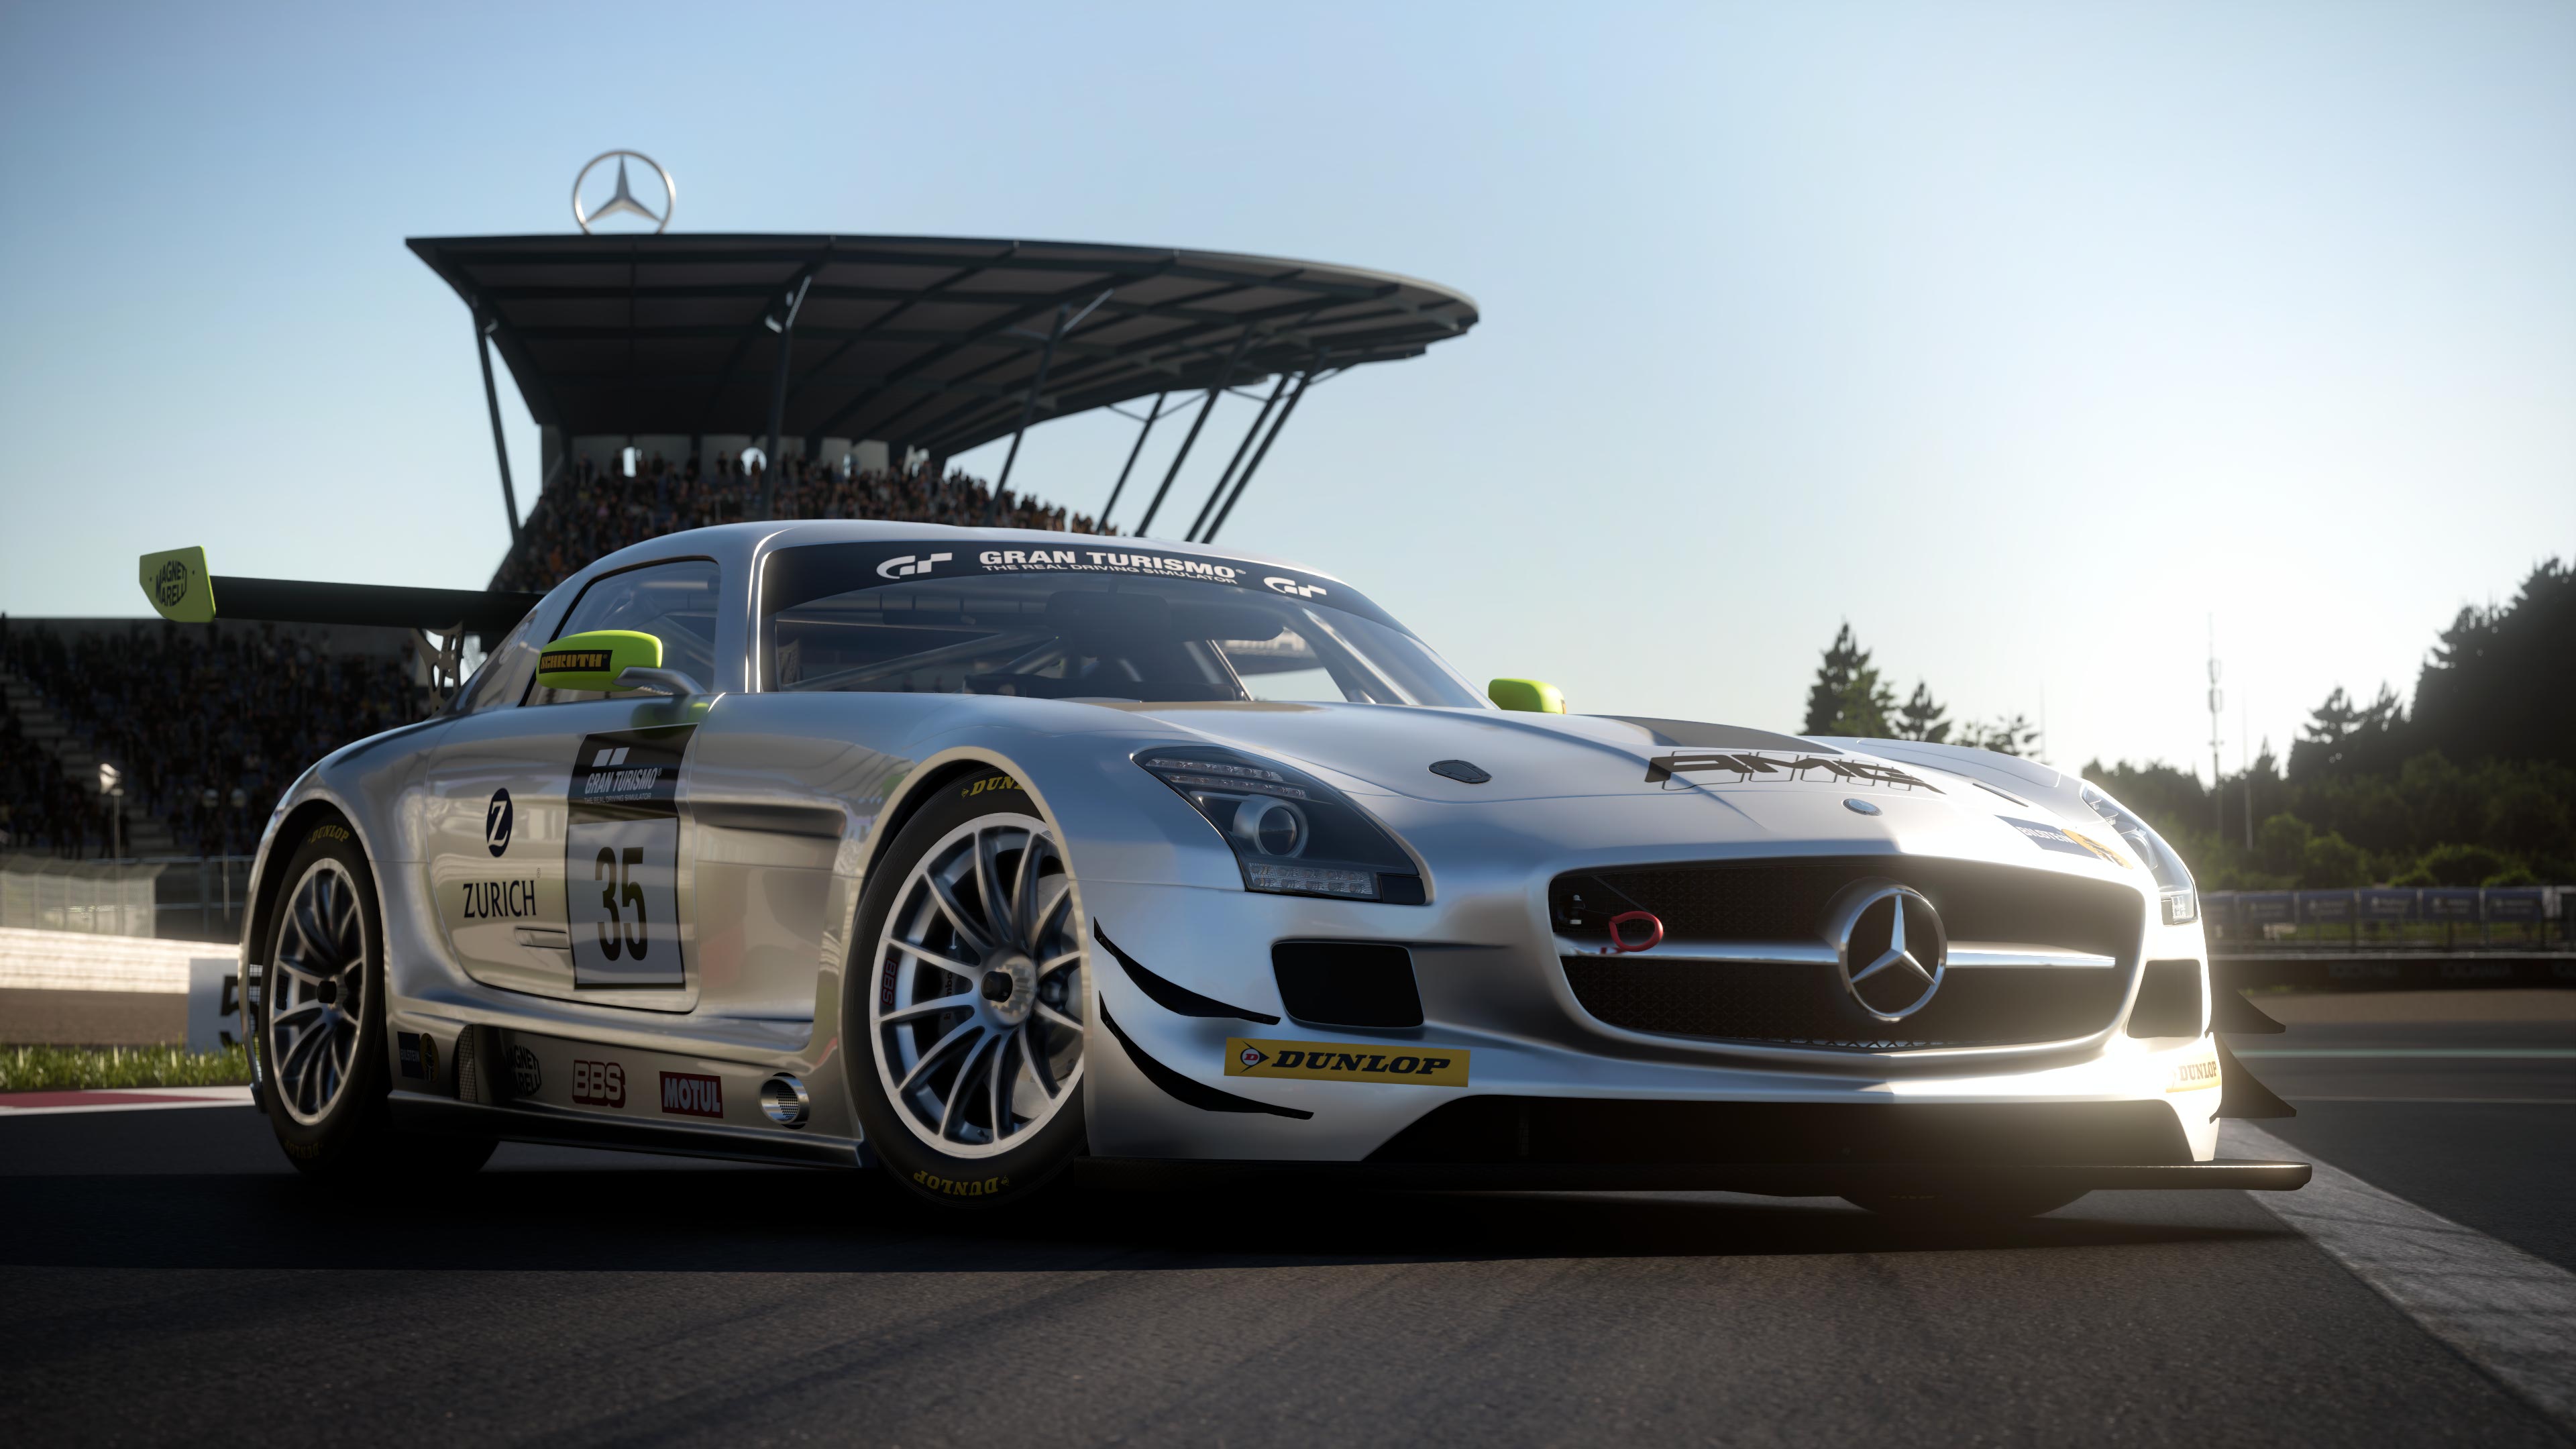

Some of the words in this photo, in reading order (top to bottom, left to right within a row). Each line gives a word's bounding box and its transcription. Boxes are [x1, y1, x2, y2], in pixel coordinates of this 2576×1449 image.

[979, 551, 1076, 565] GRAN
[1086, 552, 1236, 578] TURISMO
[1070, 564, 1140, 573] DRIVING
[1142, 568, 1238, 585] SIMULATOR
[584, 771, 614, 794] GRAN
[612, 767, 657, 792] TURISMO
[584, 797, 594, 805] THE
[594, 796, 605, 804] REAL
[605, 794, 624, 803] DRIVING
[625, 792, 651, 802] SIMULATOR
[311, 824, 350, 843] DUNLOP
[2015, 826, 2078, 845] BILSTEIN
[463, 879, 537, 918] ZURICH
[595, 846, 648, 961] 35
[881, 958, 898, 1006] BBS
[1271, 1051, 1451, 1075] DUNLOP
[2178, 1061, 2217, 1081] DUNLOP
[573, 1061, 625, 1106] BBS
[664, 1077, 720, 1112] MOTUL
[913, 1170, 999, 1196] DUNLOP
